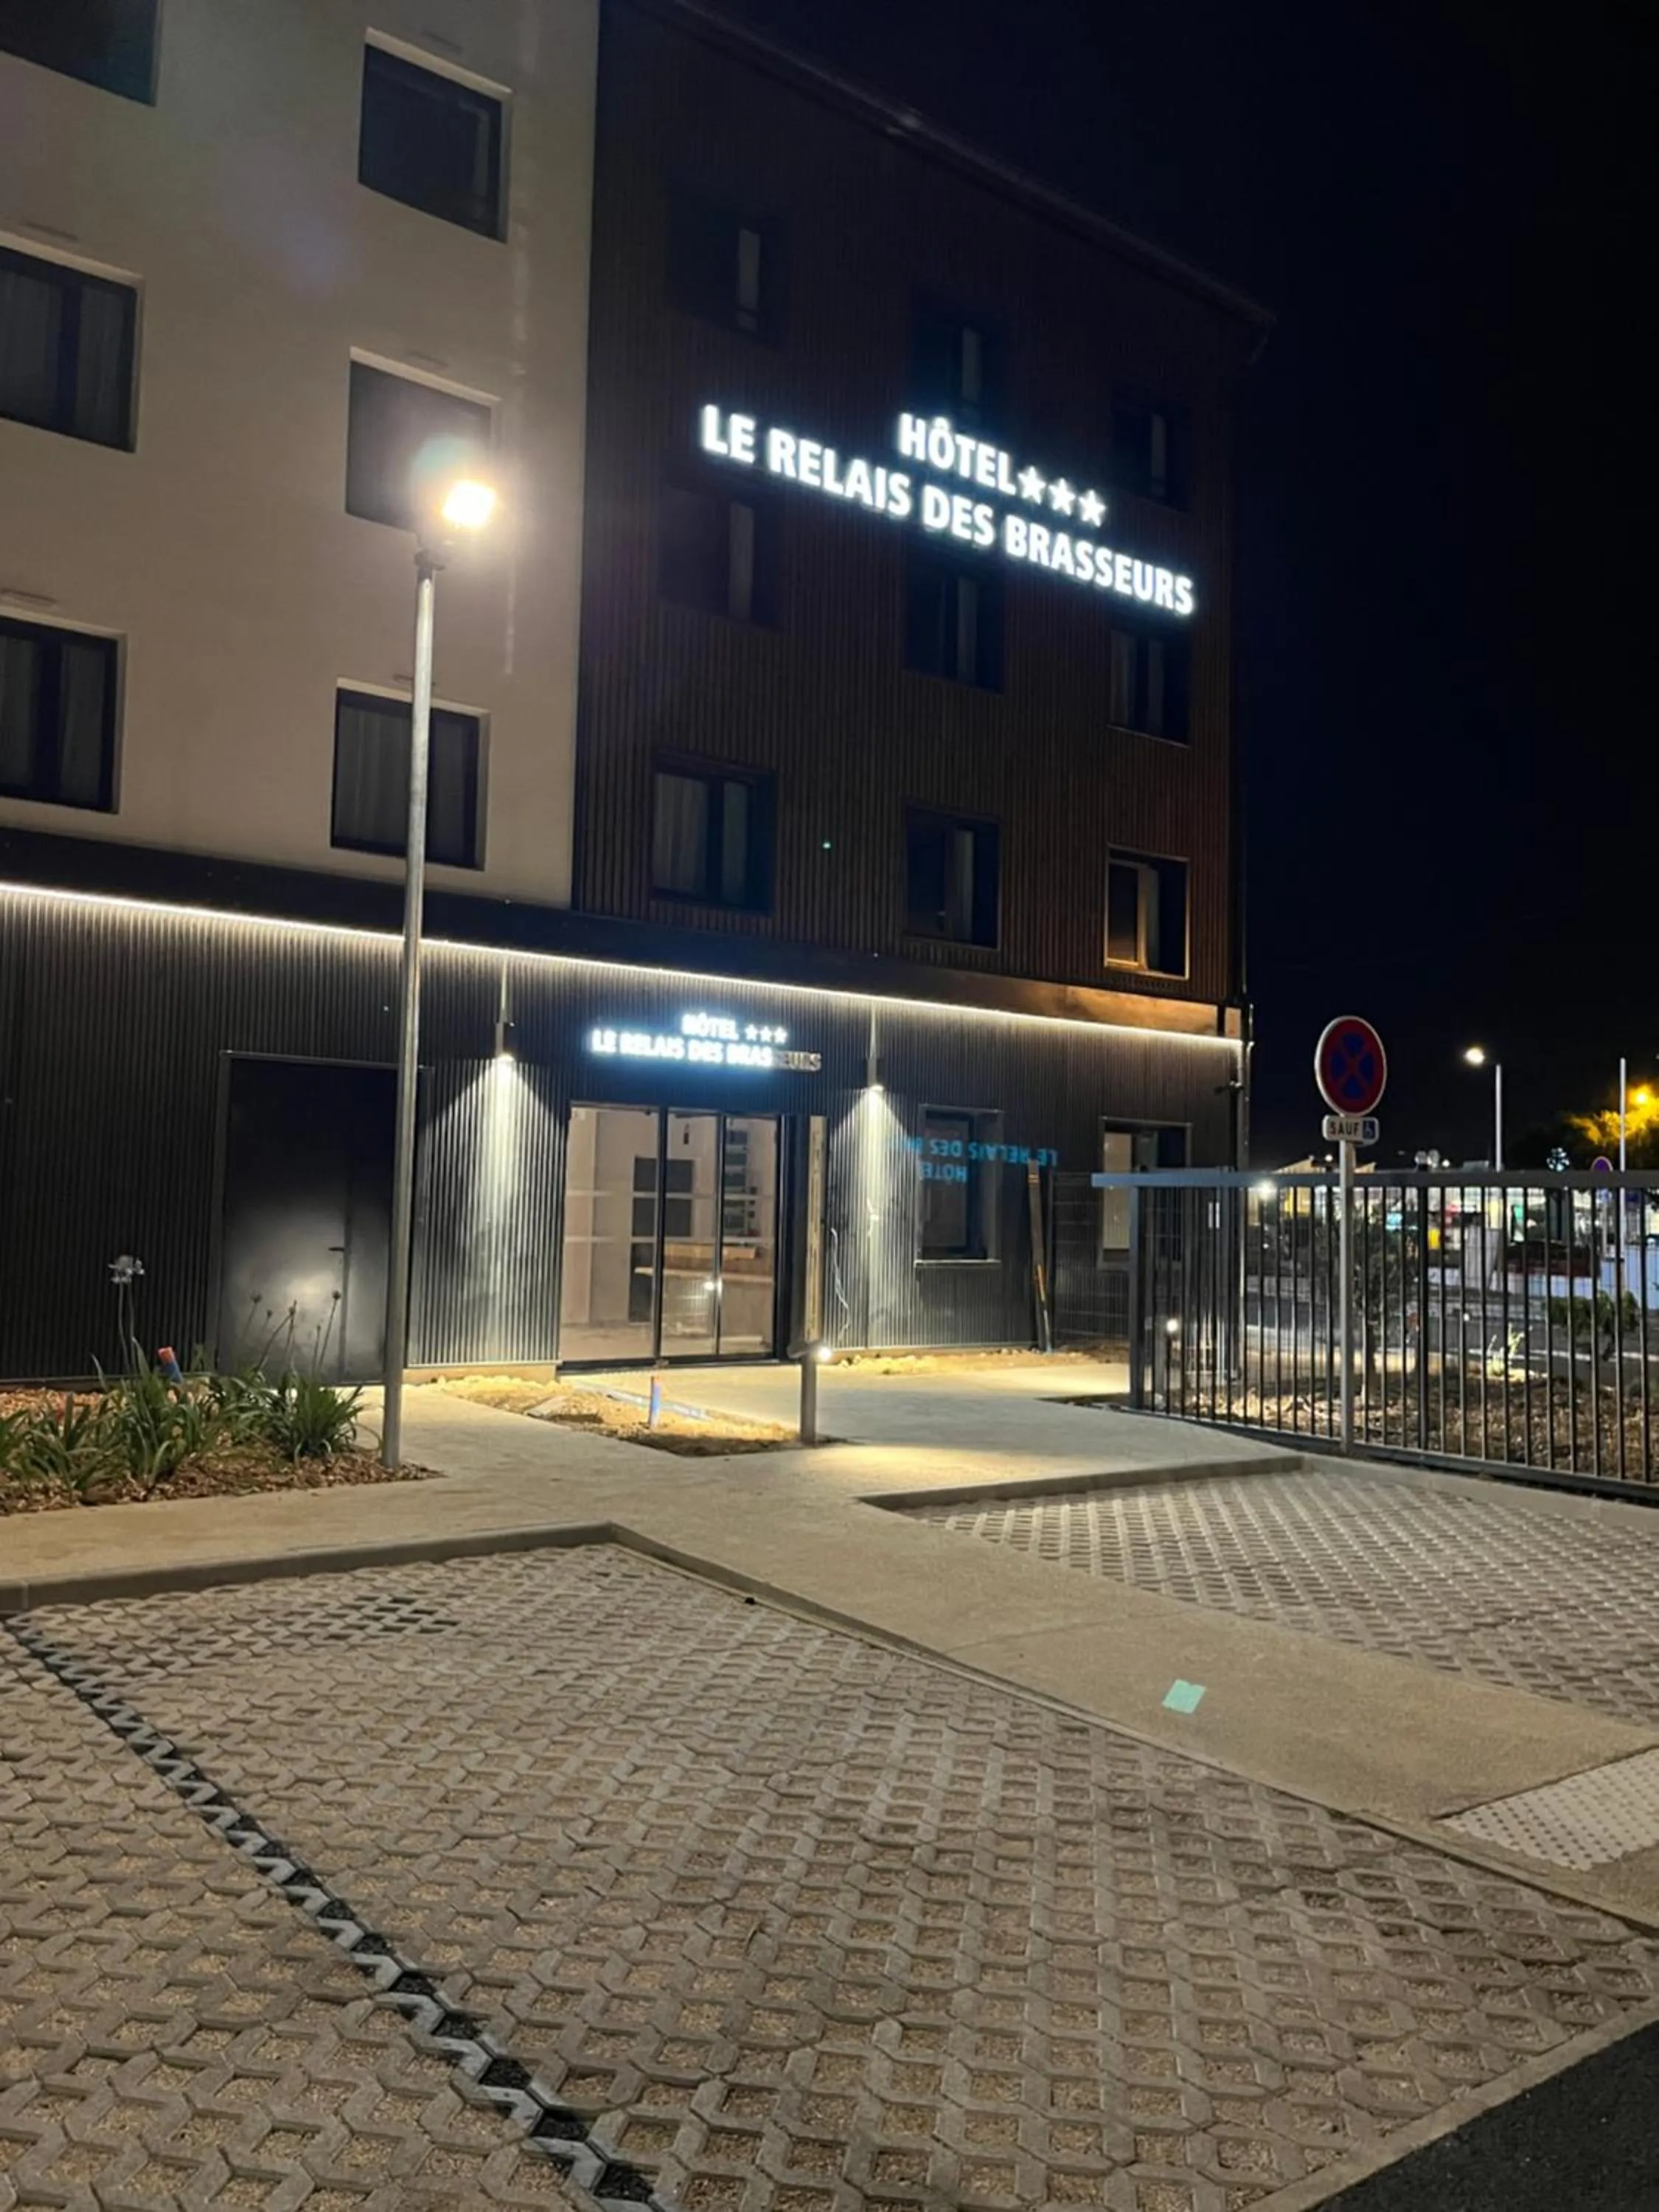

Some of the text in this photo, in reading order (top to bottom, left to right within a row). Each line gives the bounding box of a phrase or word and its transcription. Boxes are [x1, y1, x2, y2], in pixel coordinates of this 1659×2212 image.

[899, 413, 1017, 495] HÔTEL
[703, 405, 1193, 615] LE RELAIS DES BRASSEURS
[681, 1012, 739, 1040] HÔTEL
[592, 1029, 616, 1053] LE
[619, 1032, 685, 1060] RELAIS
[687, 1039, 723, 1063] DES
[1329, 1121, 1360, 1135] SAUF
